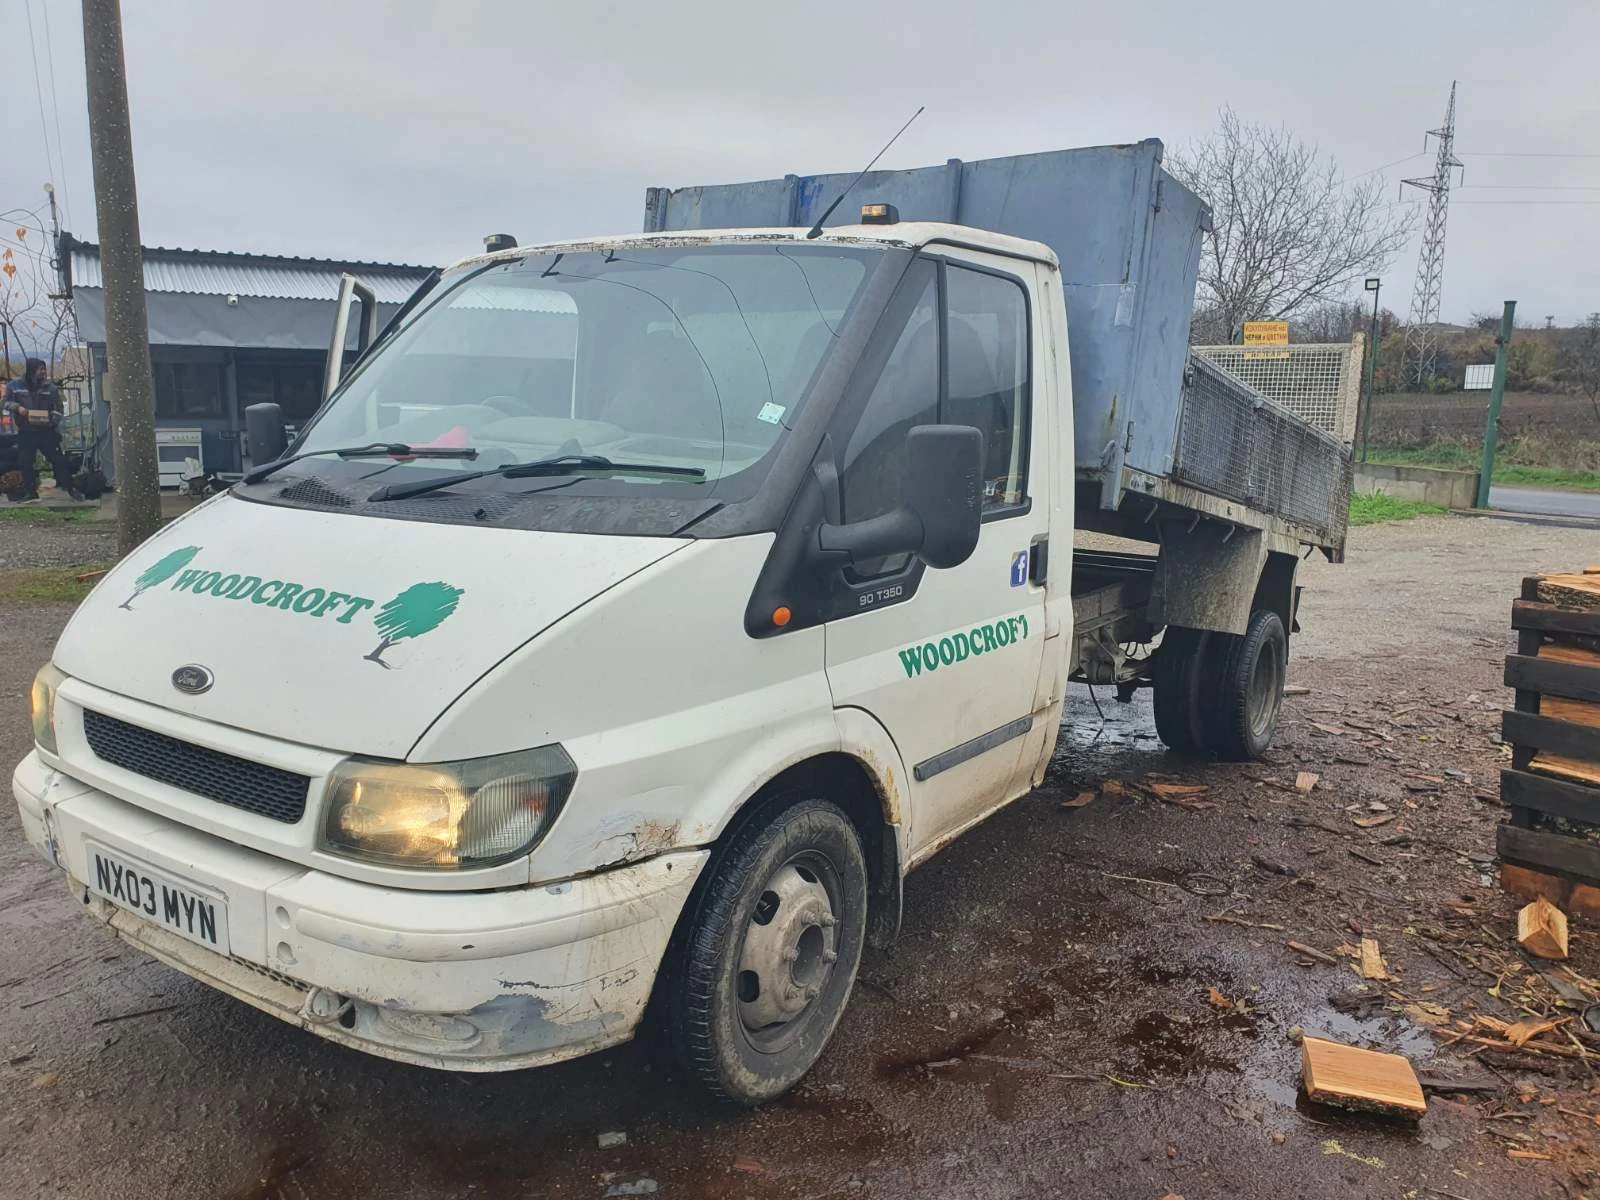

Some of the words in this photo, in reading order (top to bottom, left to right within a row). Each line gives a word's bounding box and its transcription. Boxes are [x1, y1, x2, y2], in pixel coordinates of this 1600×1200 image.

[170, 568, 375, 624] WOODCROFT
[859, 593, 874, 606] 90
[876, 585, 903, 601] T350
[95, 854, 157, 916] NX03
[162, 885, 217, 944] MYN
